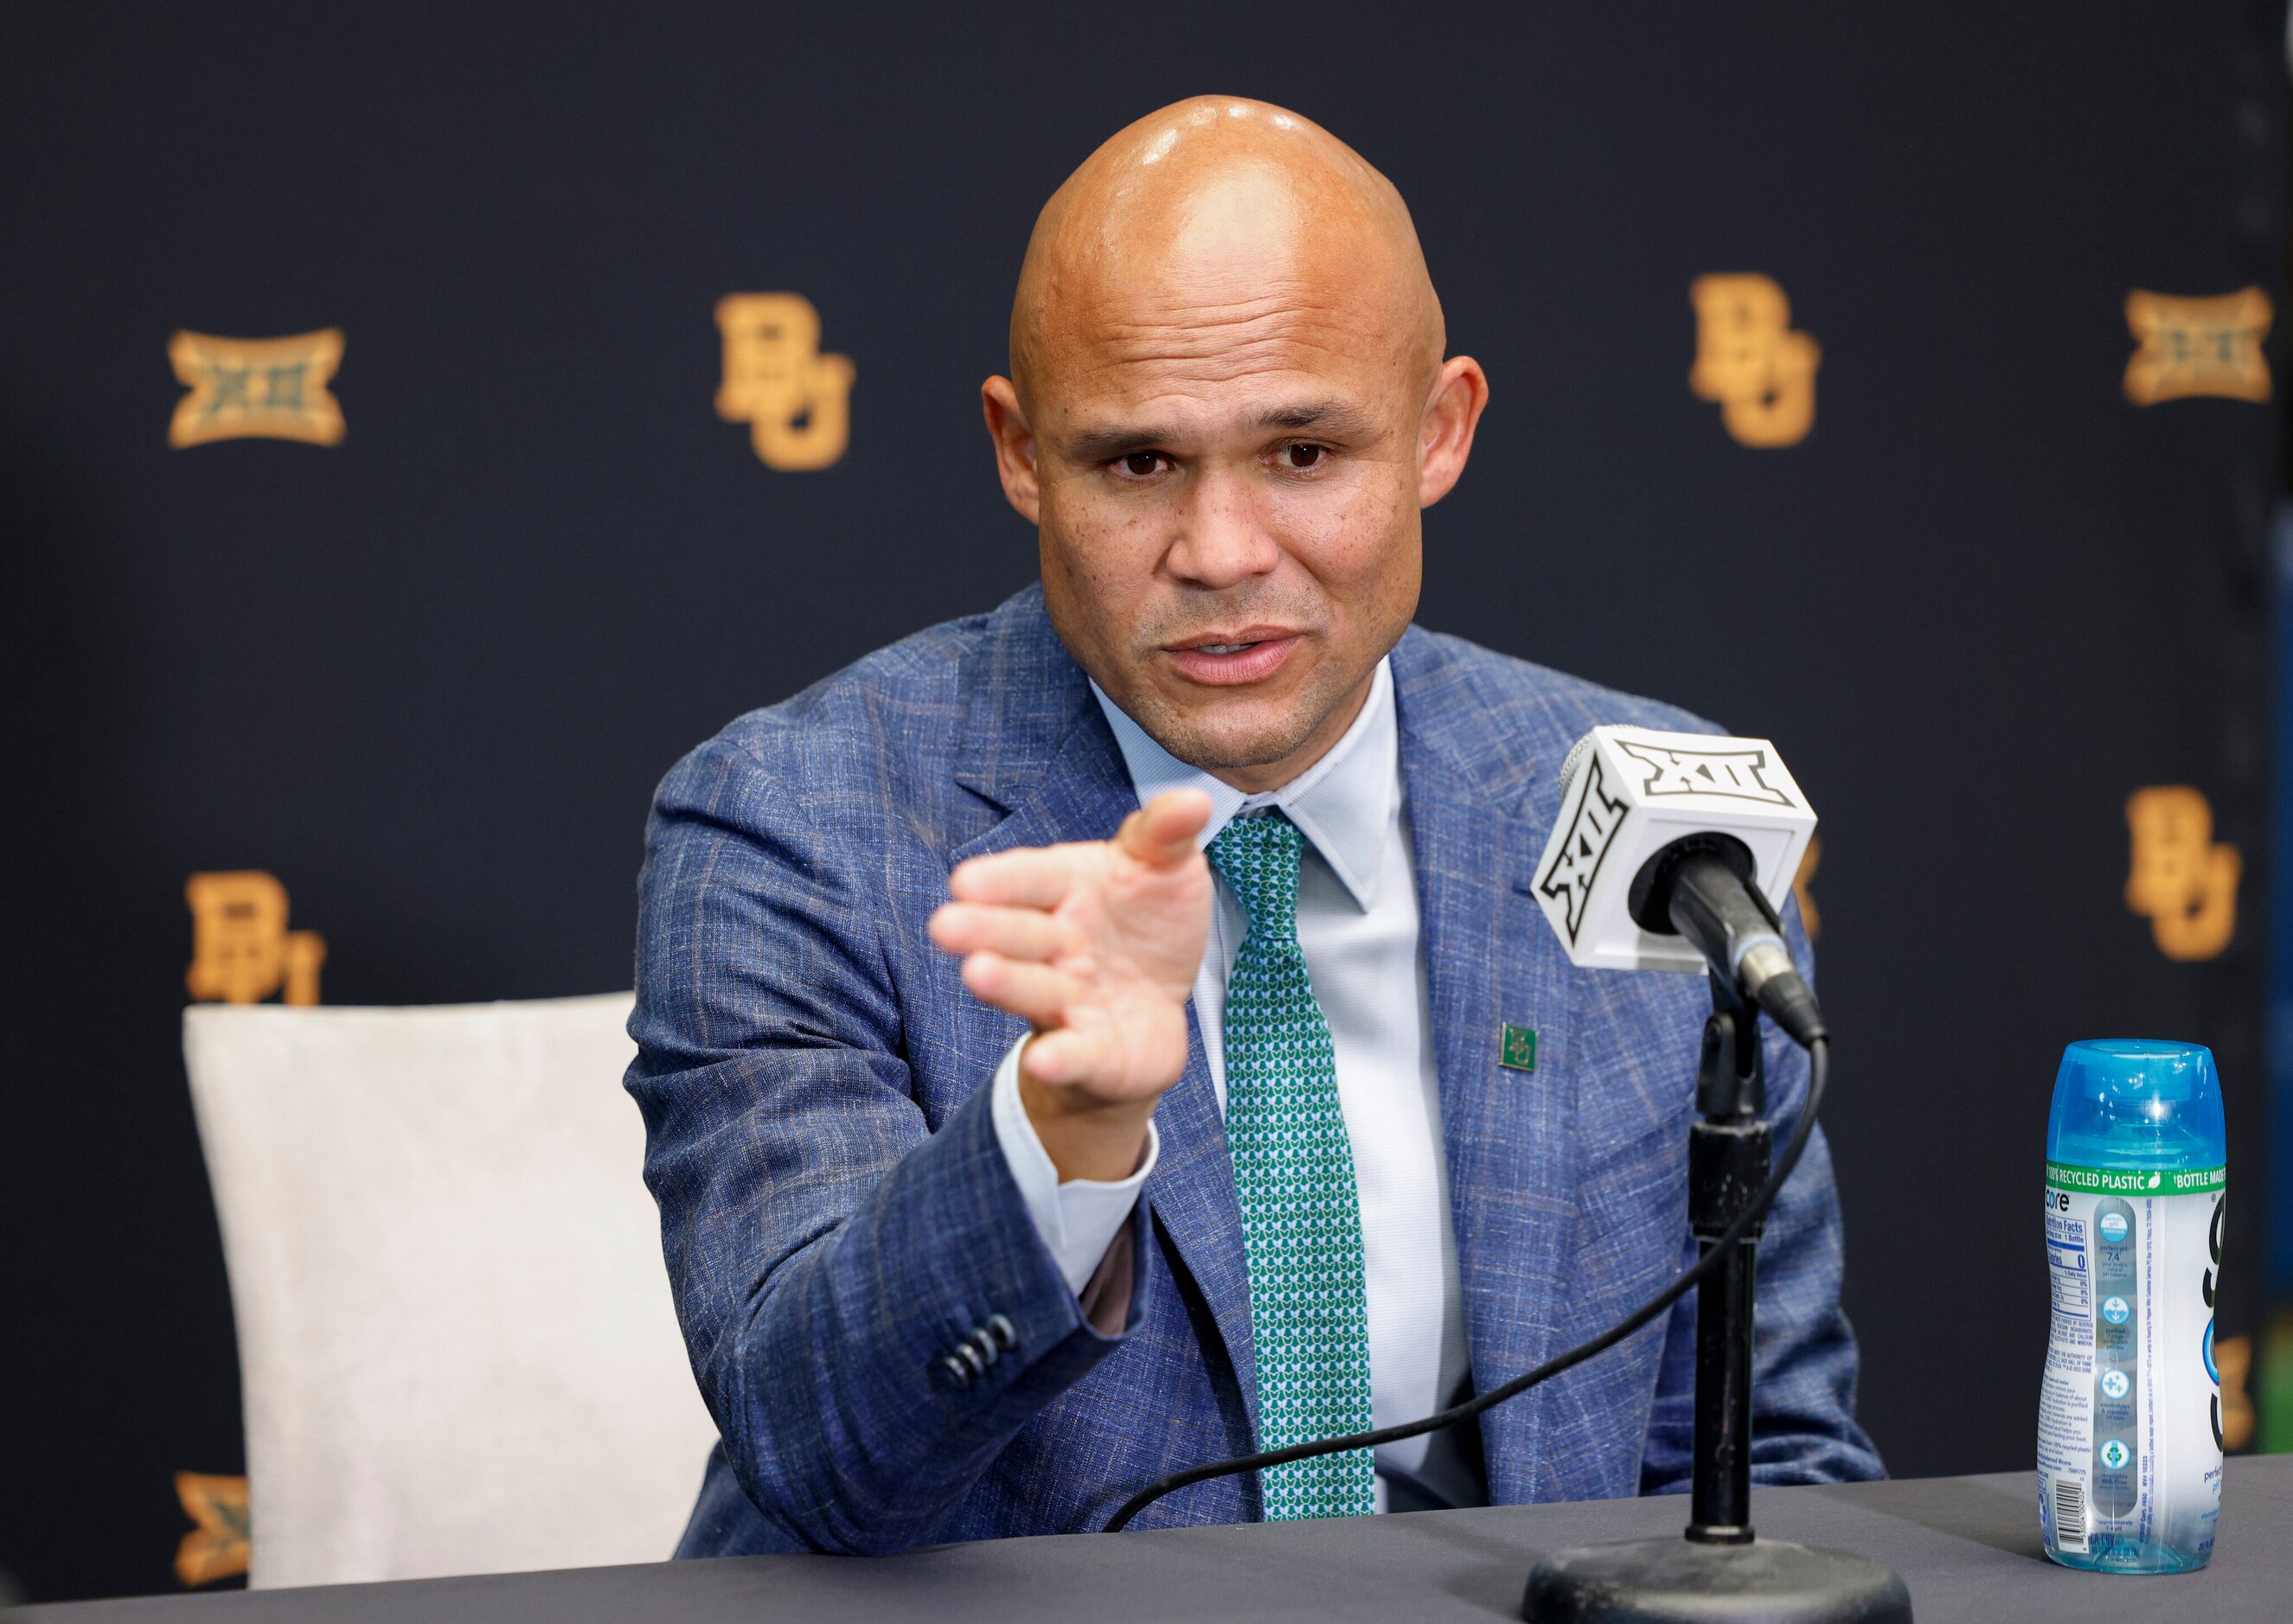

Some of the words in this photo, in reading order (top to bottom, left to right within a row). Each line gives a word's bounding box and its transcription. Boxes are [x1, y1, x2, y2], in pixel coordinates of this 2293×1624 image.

[2059, 1168, 2099, 1187] RECYCLED
[2102, 1174, 2145, 1190] PLASTIC
[2064, 1220, 2083, 1233] Facts
[2068, 1234, 2084, 1244] Bottle
[2078, 1254, 2085, 1269] 0
[2108, 1252, 2120, 1261] 7.4
